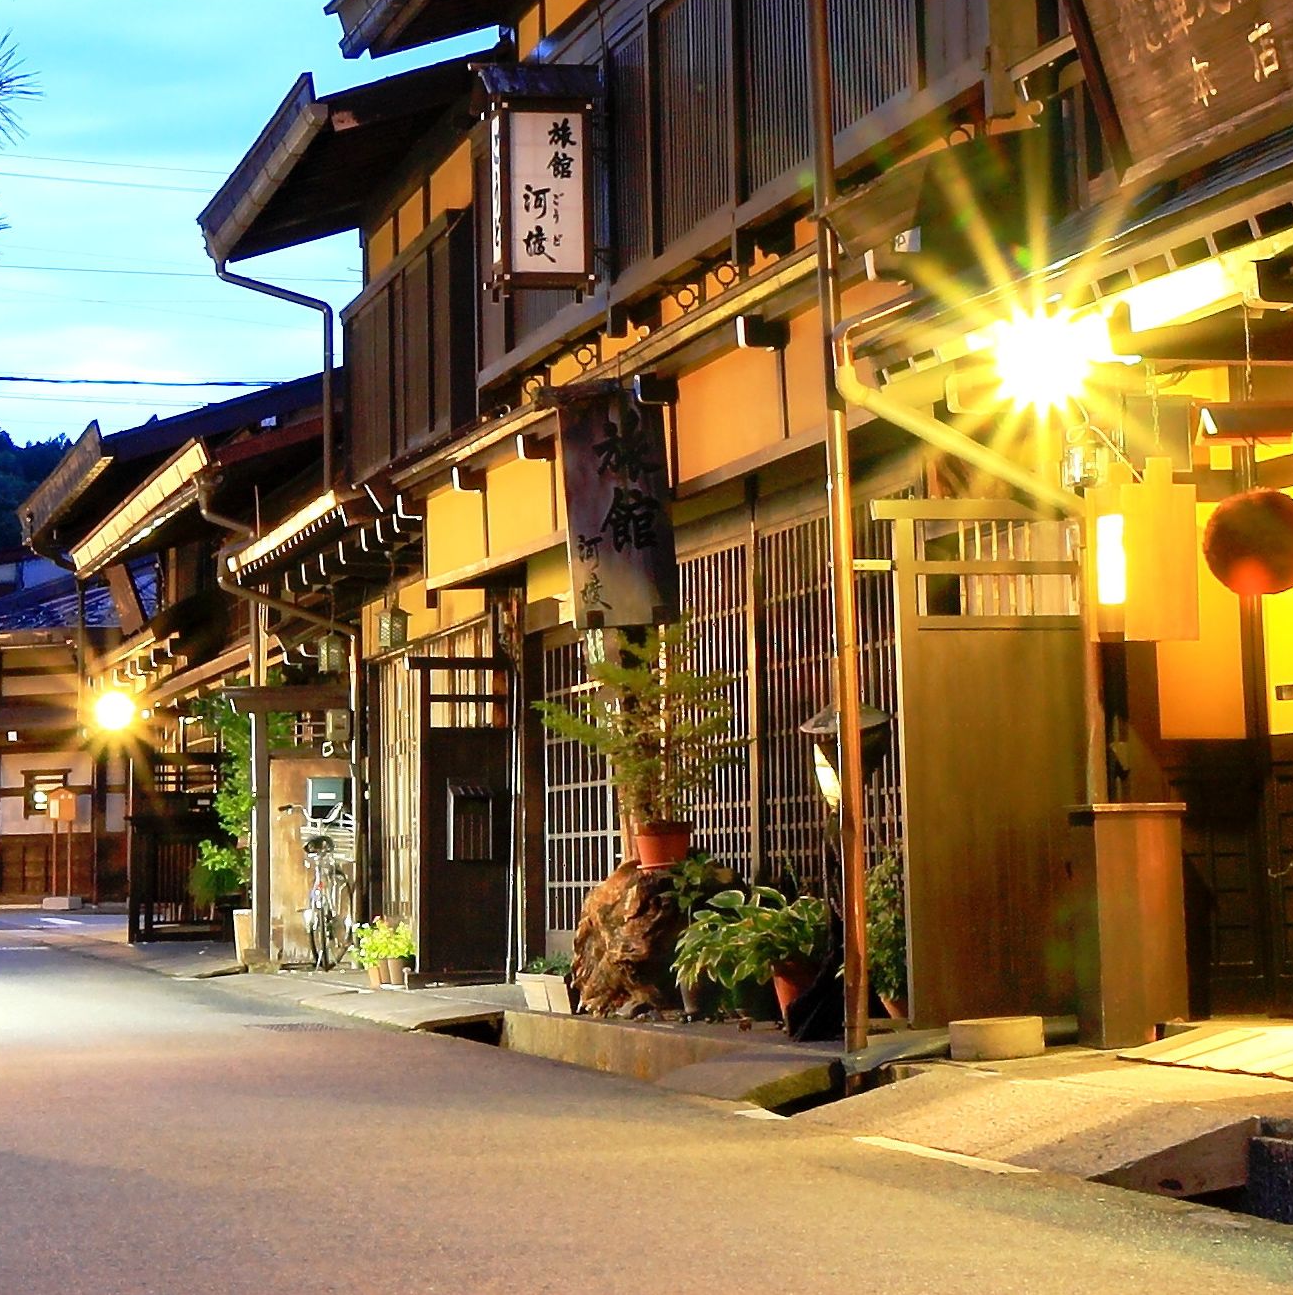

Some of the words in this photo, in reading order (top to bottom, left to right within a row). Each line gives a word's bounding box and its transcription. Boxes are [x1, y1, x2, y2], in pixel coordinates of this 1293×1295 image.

[546, 117, 577, 180] 旅館
[552, 192, 565, 248] ごうど
[592, 406, 663, 554] 旅館
